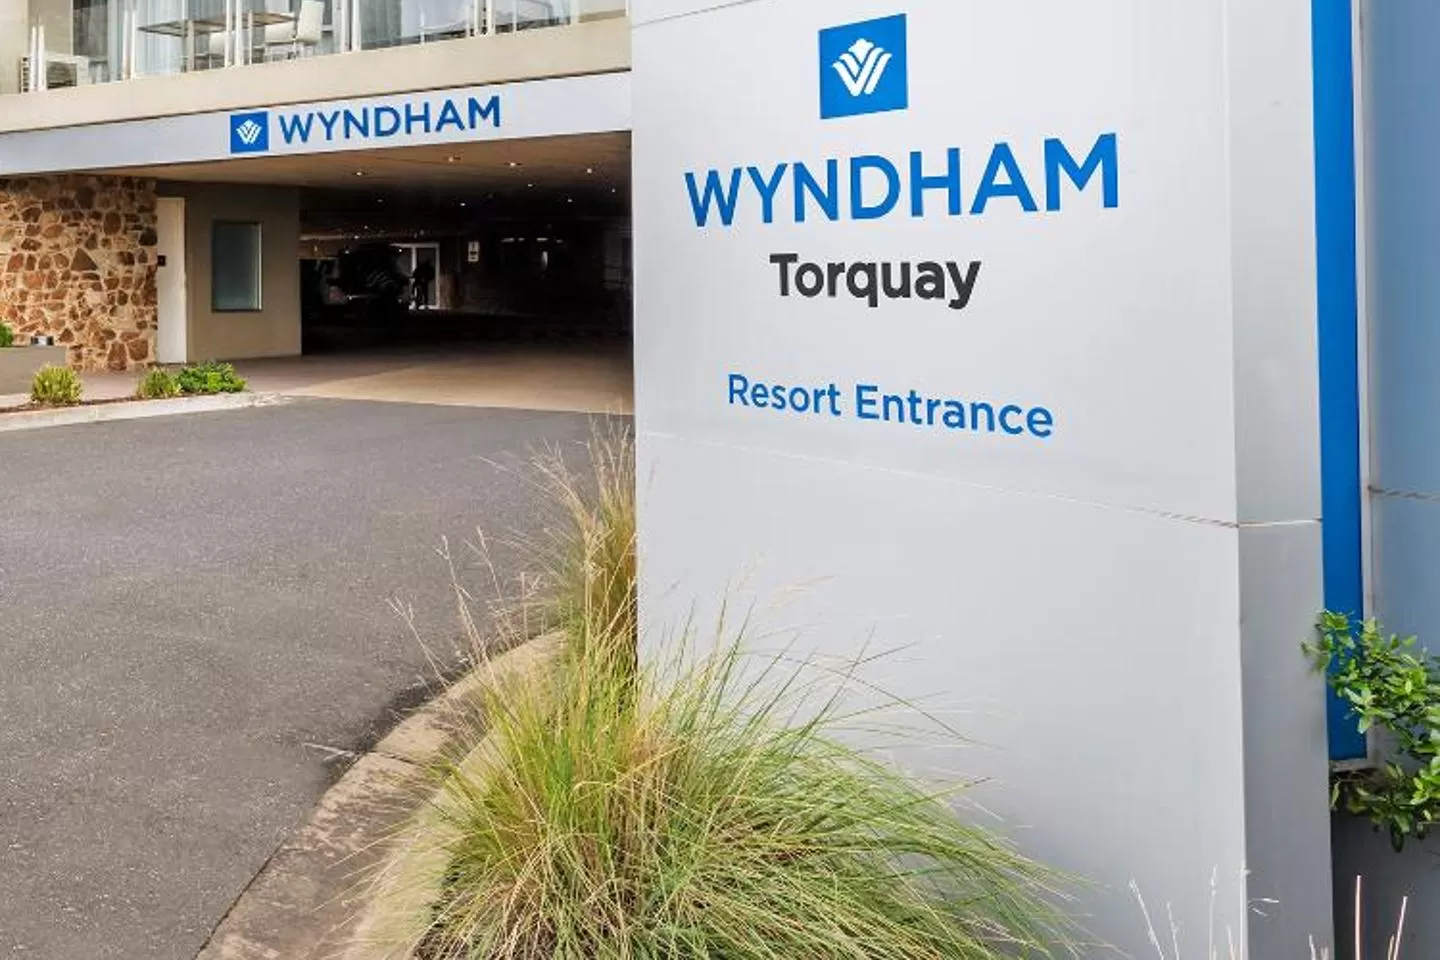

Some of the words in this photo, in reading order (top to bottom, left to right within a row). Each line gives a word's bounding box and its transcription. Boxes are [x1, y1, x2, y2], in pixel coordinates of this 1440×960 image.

[279, 95, 502, 145] WYNDHAM
[684, 132, 1120, 228] WYNDHAM
[769, 253, 982, 310] Torquay
[727, 373, 841, 417] Resort
[855, 383, 1054, 438] Entrance
